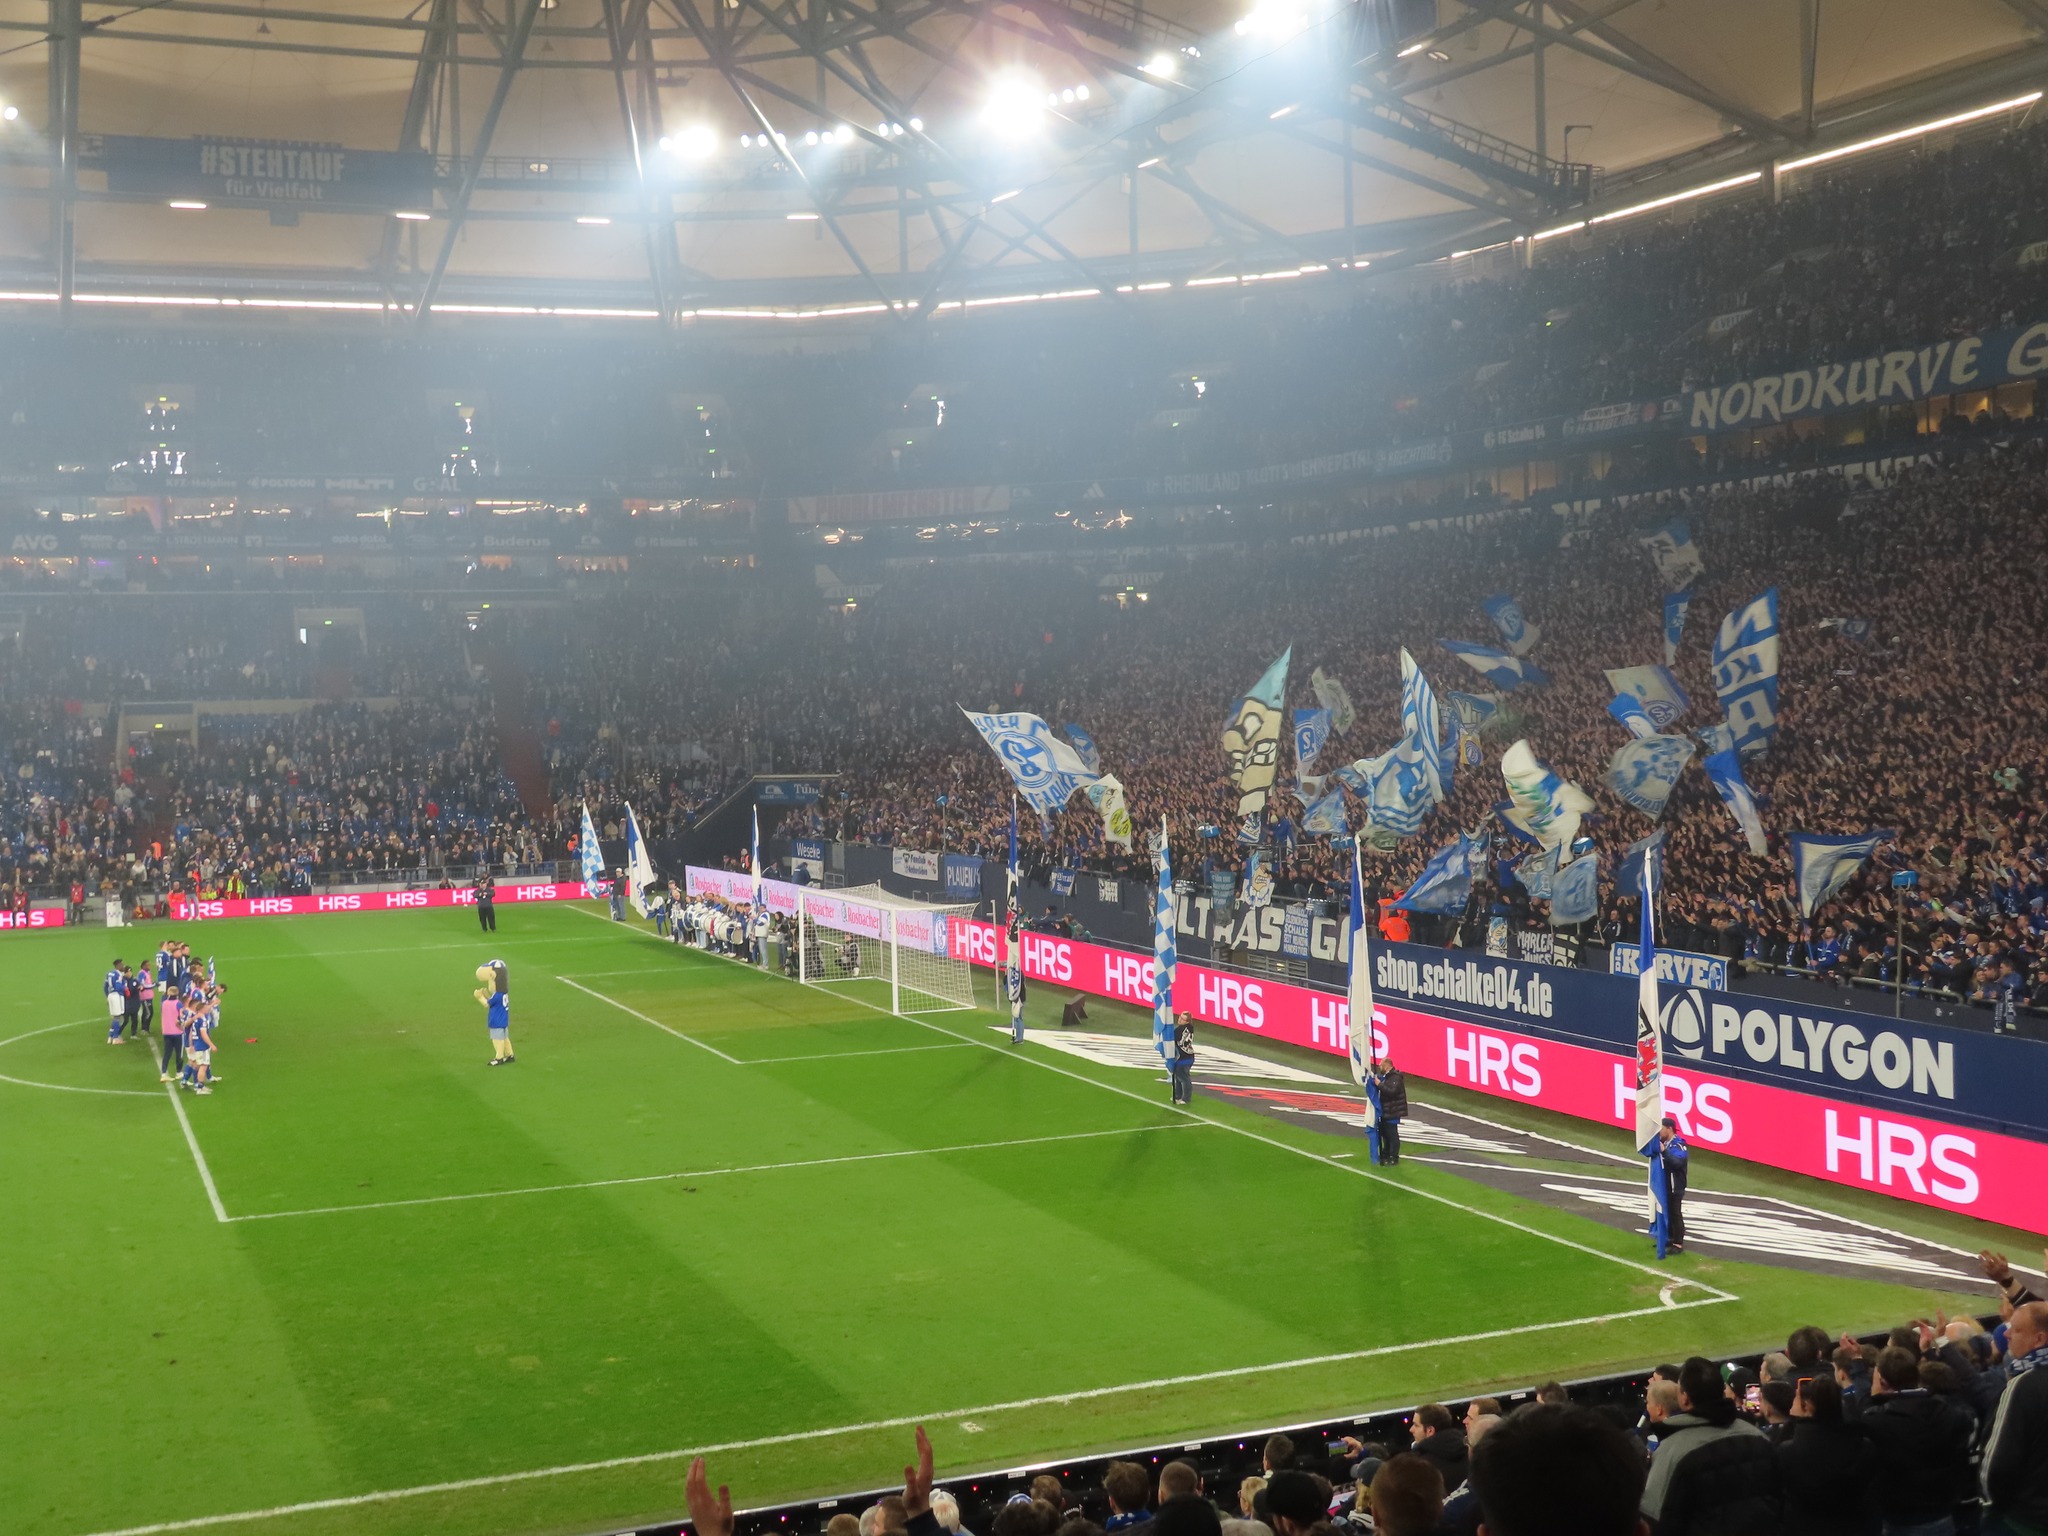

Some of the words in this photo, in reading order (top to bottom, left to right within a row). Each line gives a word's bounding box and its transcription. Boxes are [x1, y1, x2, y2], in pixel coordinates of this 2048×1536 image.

[200, 145, 345, 182] #STEHTAUF
[226, 179, 252, 198] für
[256, 181, 323, 200] Vielfalt
[1690, 337, 1983, 430] NORDKURVE
[261, 478, 316, 488] POLYGON
[11, 534, 58, 550] AVG
[483, 535, 551, 547] Buderus
[796, 842, 821, 859] Weseke
[517, 885, 556, 899] HRS
[694, 876, 722, 894] Rosbacher
[250, 899, 292, 913] HRS
[319, 896, 360, 910] HRS
[387, 892, 427, 907] HRS
[453, 890, 475, 903] HR
[768, 890, 795, 909] Rosbacher
[848, 907, 880, 929] Rosbacher
[955, 922, 995, 963] HRS
[1517, 930, 1554, 954] MARLER
[1024, 936, 1073, 981] HRS
[1622, 948, 1710, 989] KRVE
[1377, 949, 1553, 1019] shop.schalke04.de
[1199, 973, 1264, 1029] HRS
[1446, 1027, 1542, 1097] HRS
[1711, 1003, 1955, 1100] POLYGON
[1825, 1108, 1980, 1204] HRS
